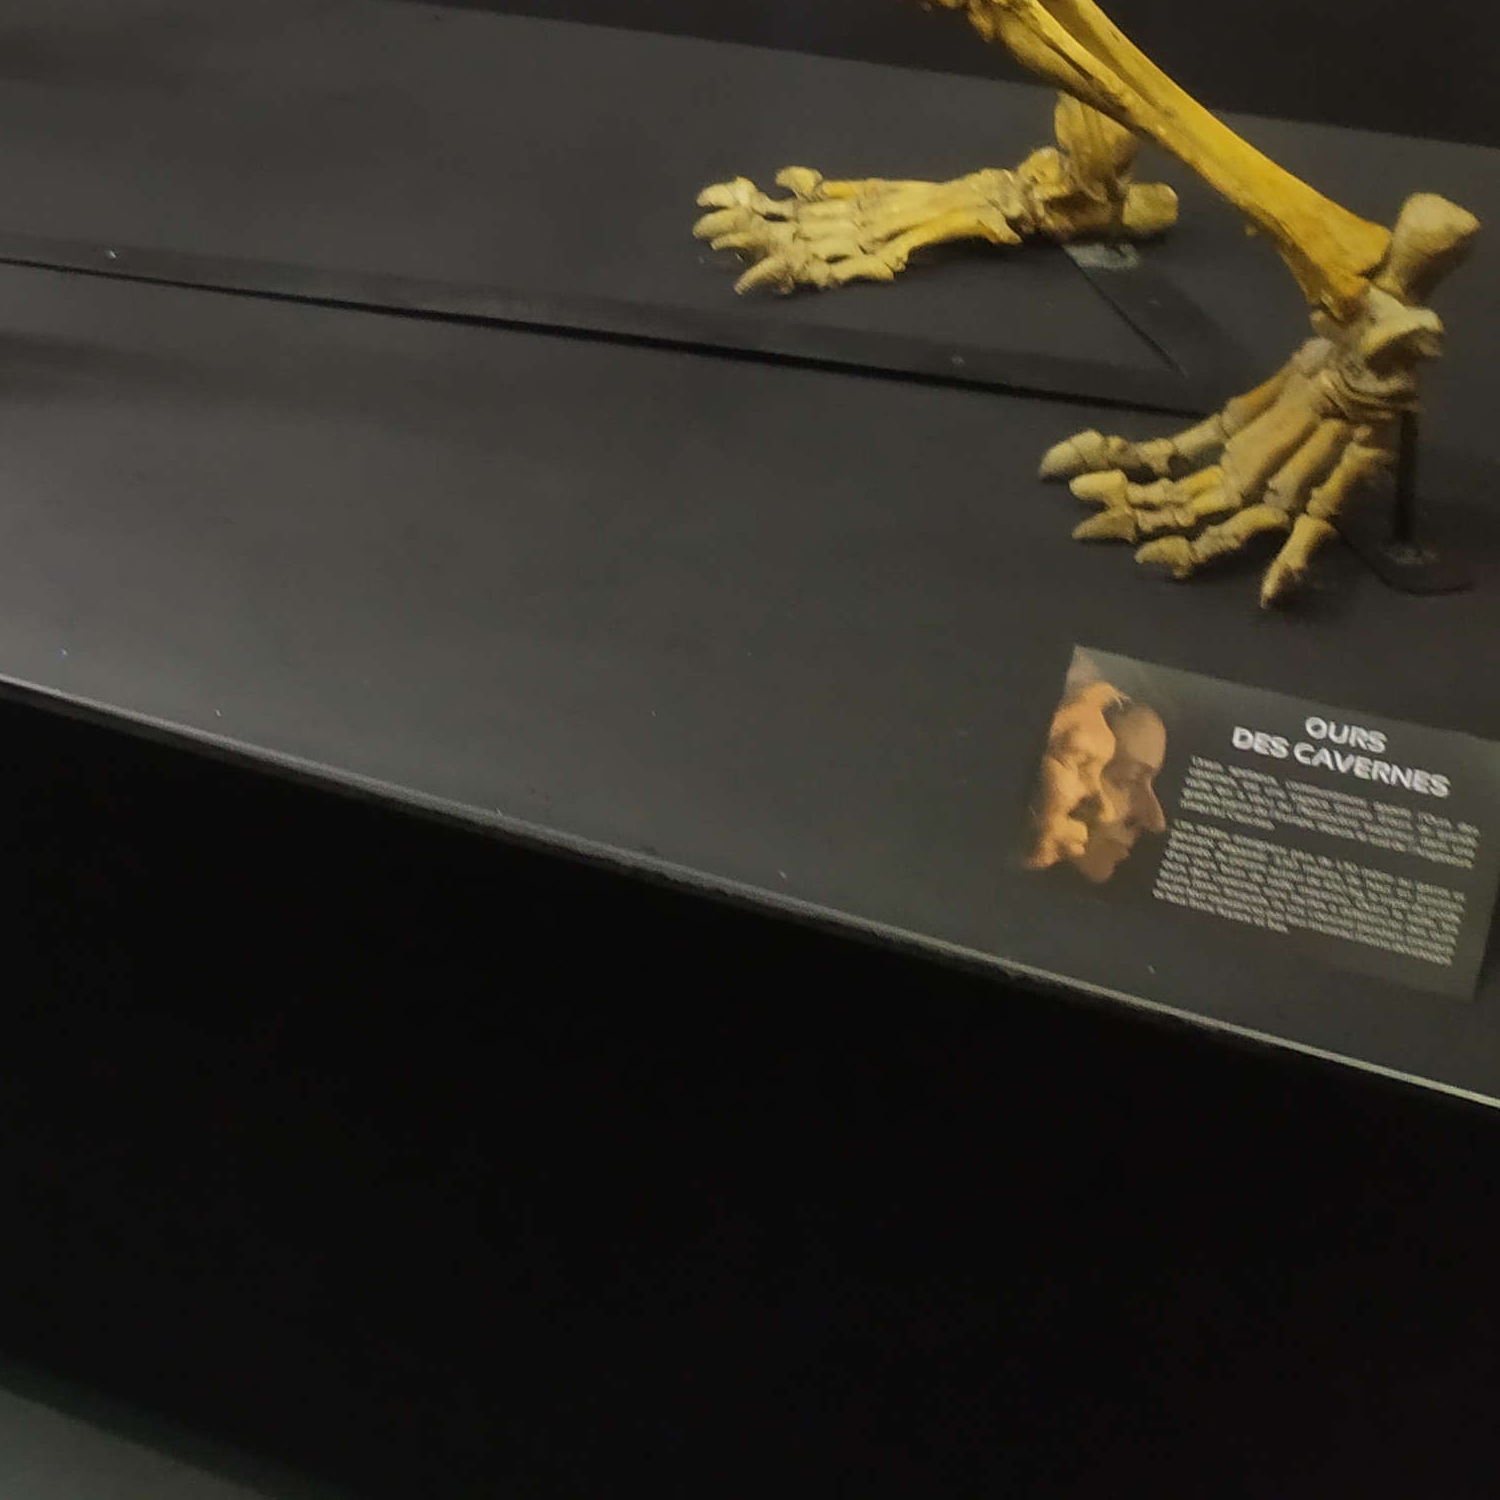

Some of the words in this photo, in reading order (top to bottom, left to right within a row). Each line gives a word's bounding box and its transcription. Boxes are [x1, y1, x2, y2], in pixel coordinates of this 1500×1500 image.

[1231, 725, 1290, 759] DES
[1293, 741, 1452, 799] CAVERNES
[1305, 716, 1388, 754] OURS
